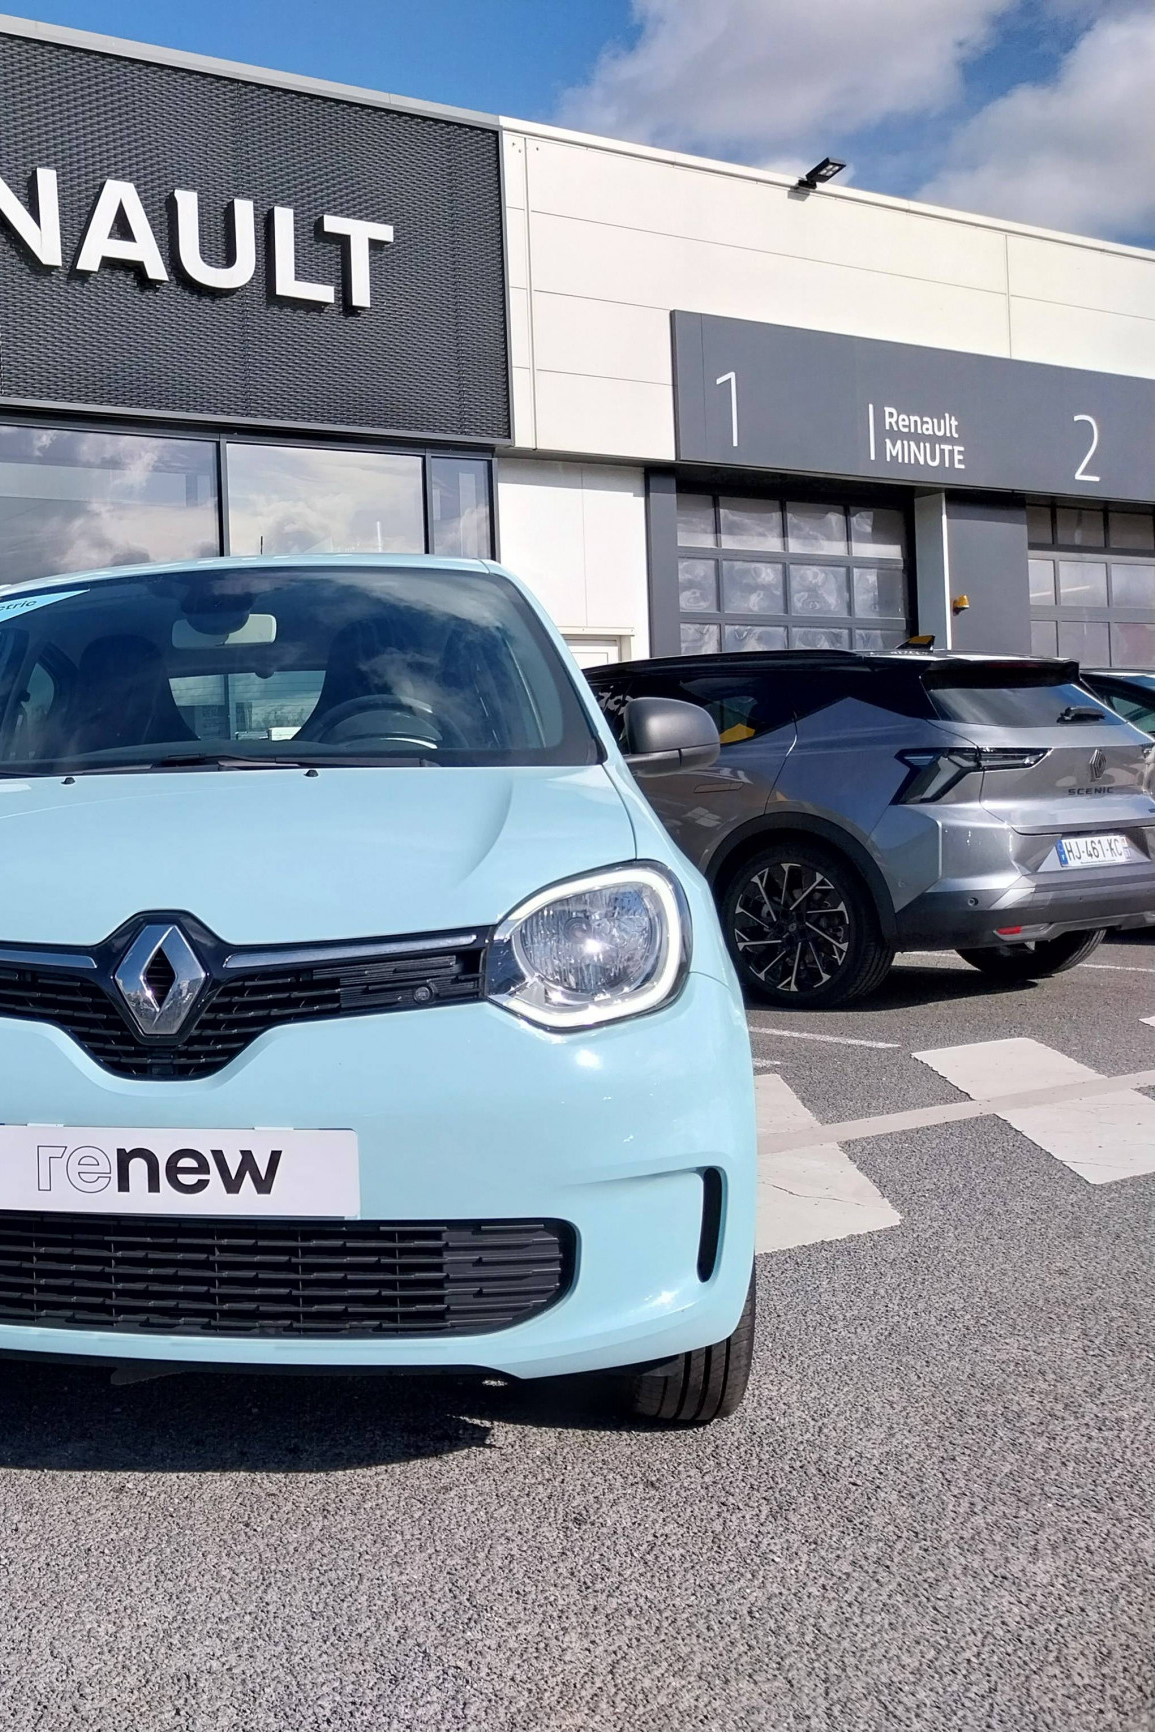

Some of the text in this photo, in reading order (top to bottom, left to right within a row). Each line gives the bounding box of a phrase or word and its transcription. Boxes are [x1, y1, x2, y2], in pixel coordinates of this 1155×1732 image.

[716, 371, 738, 447] 1
[884, 406, 959, 438] Renault
[885, 438, 965, 470] MINUTE
[1073, 413, 1101, 482] 2
[1068, 787, 1114, 795] SCENIC
[37, 1144, 283, 1195] renew
